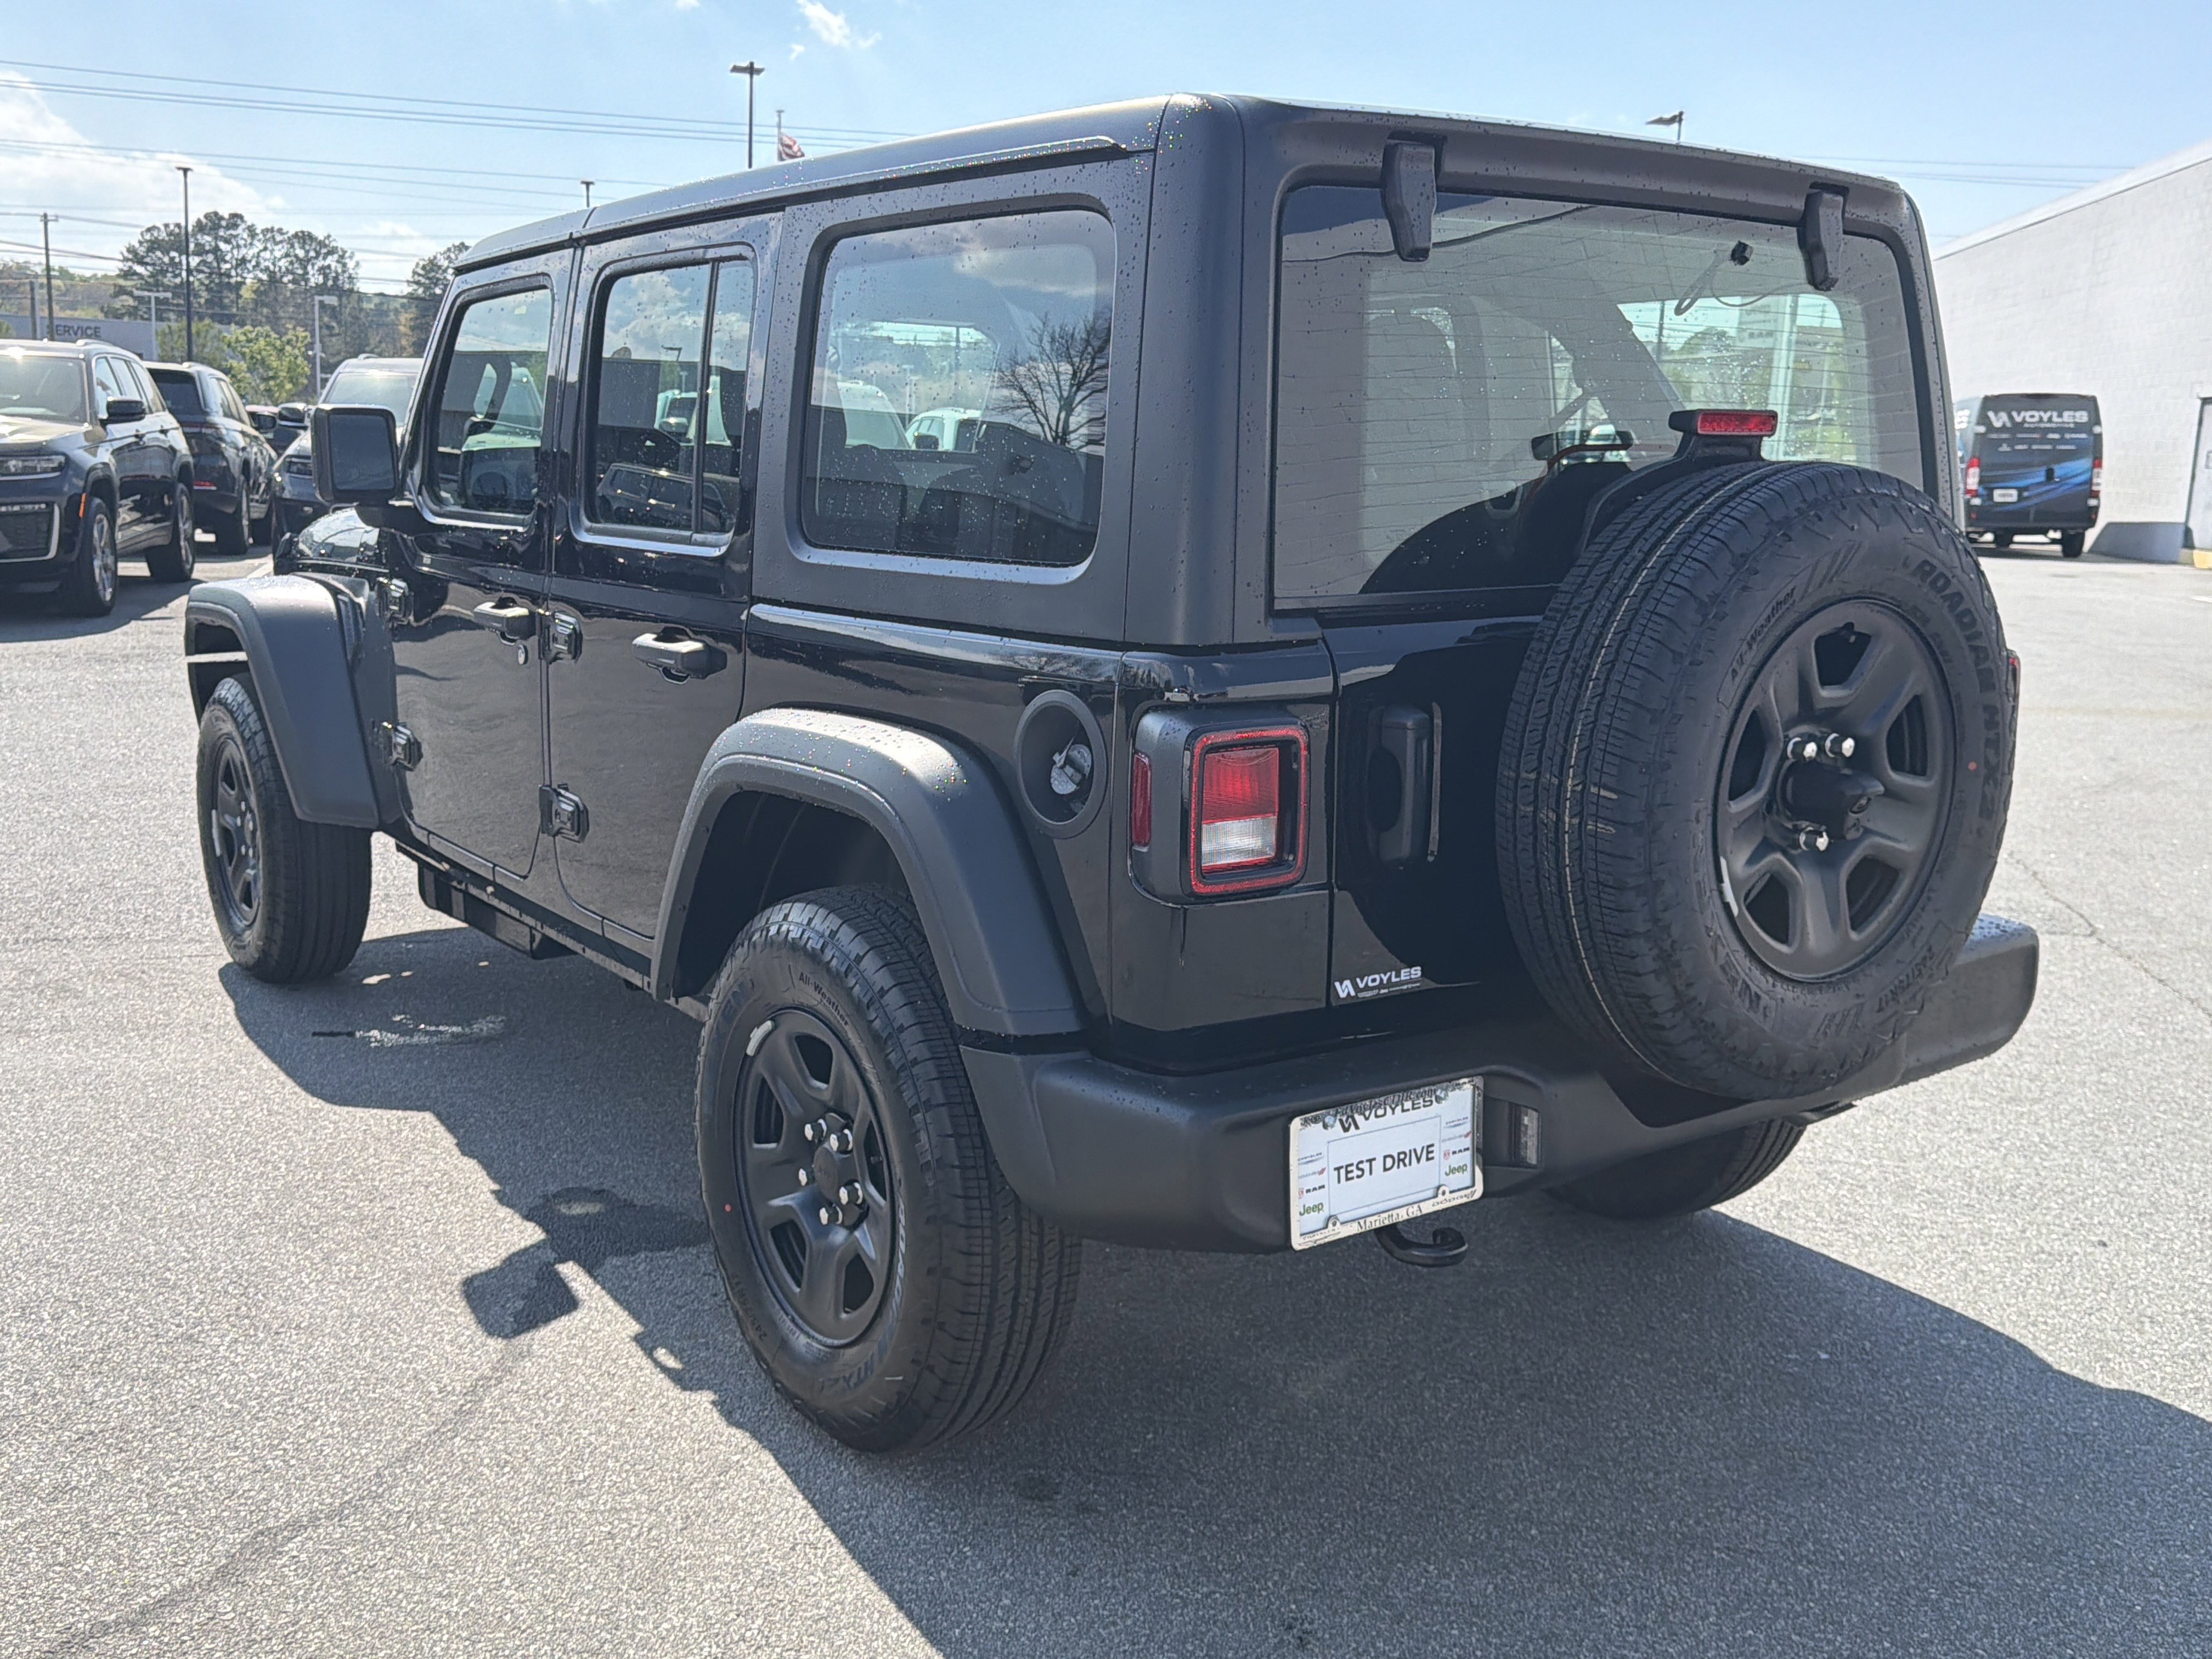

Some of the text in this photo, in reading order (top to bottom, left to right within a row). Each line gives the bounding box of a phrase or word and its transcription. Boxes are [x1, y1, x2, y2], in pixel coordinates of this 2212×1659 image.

[2012, 410, 2089, 422] VOYLES
[1356, 966, 1422, 989] VOYLES
[799, 972, 849, 1027] All-Weather
[1362, 1096, 1434, 1121] VOYLES
[1334, 1143, 1435, 1184] TEST DRIVE
[1444, 1164, 1468, 1177] Jeep
[1299, 1202, 1324, 1216] Jeep
[1406, 1204, 1423, 1217] GA
